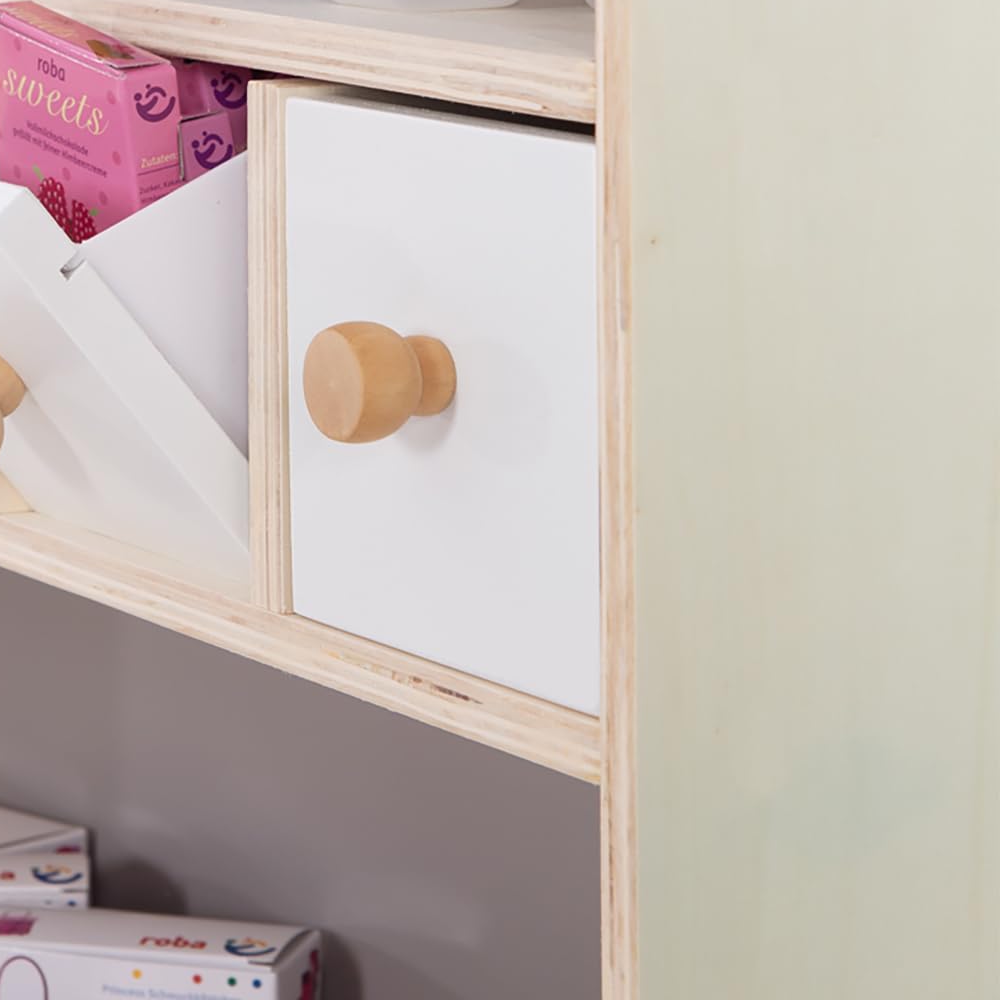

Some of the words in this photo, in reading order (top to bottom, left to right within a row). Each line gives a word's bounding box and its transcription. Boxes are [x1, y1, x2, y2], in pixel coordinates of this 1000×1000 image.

[37, 58, 66, 82] roba
[2, 68, 110, 136] sweets
[139, 935, 207, 951] roba
